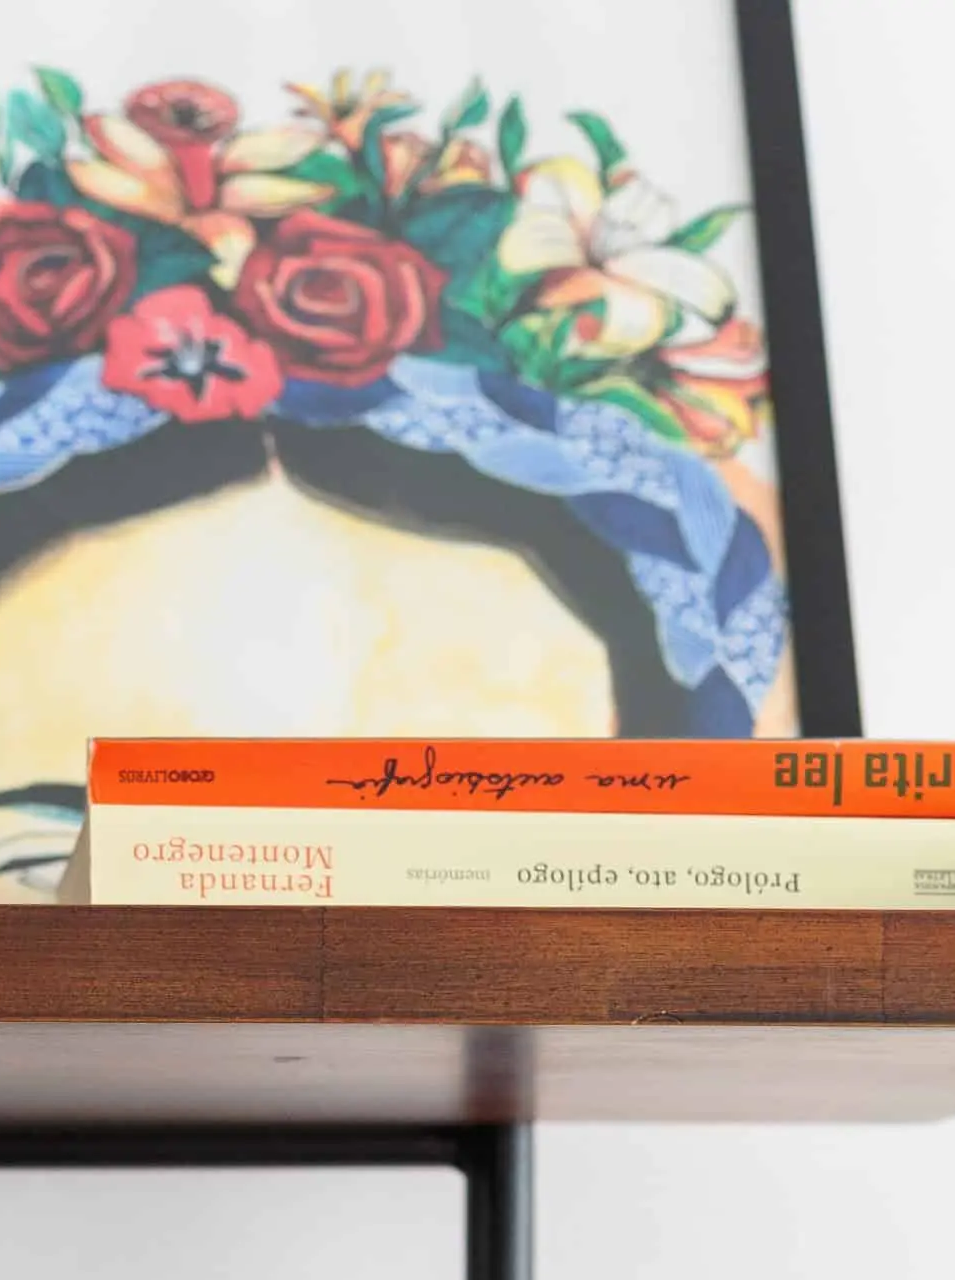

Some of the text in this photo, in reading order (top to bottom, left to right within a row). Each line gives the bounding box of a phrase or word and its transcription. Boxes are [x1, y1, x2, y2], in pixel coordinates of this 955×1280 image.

[775, 752, 951, 806] rita lee
[133, 837, 332, 869] Montenegro
[181, 873, 332, 898] Fernanda
[407, 869, 490, 884] memórias
[518, 864, 799, 894] Prólogo, ato, epílogo
